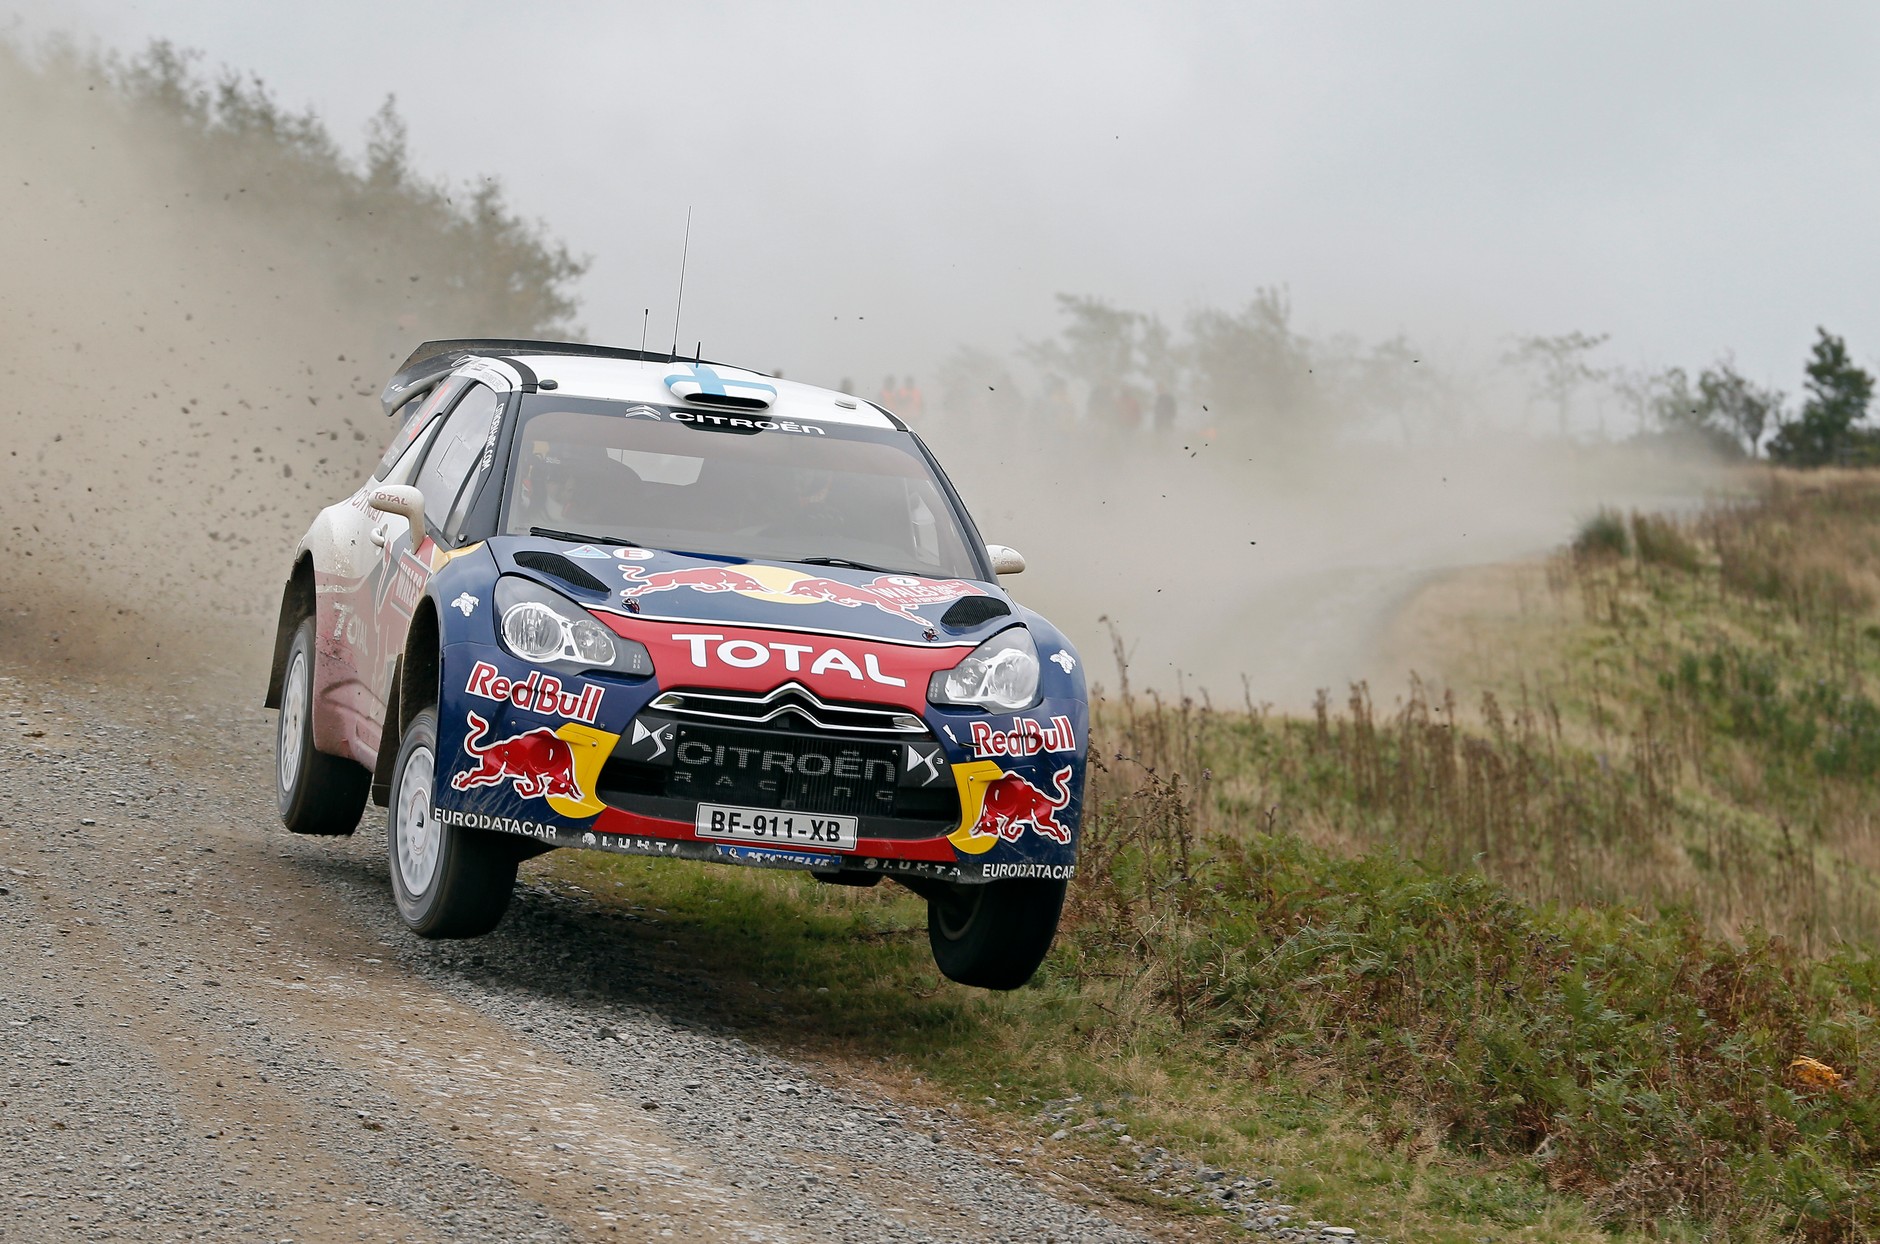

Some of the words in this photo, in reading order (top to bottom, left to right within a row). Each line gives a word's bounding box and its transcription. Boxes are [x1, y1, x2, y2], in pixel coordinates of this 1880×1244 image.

[374, 491, 408, 506] TOTAL
[623, 549, 643, 559] E
[872, 585, 940, 599] WALES
[671, 633, 906, 687] TOTAL
[434, 808, 557, 839] EURODATACAR
[711, 810, 841, 842] BF-911-XB
[983, 863, 1075, 880] EURODATACAR
